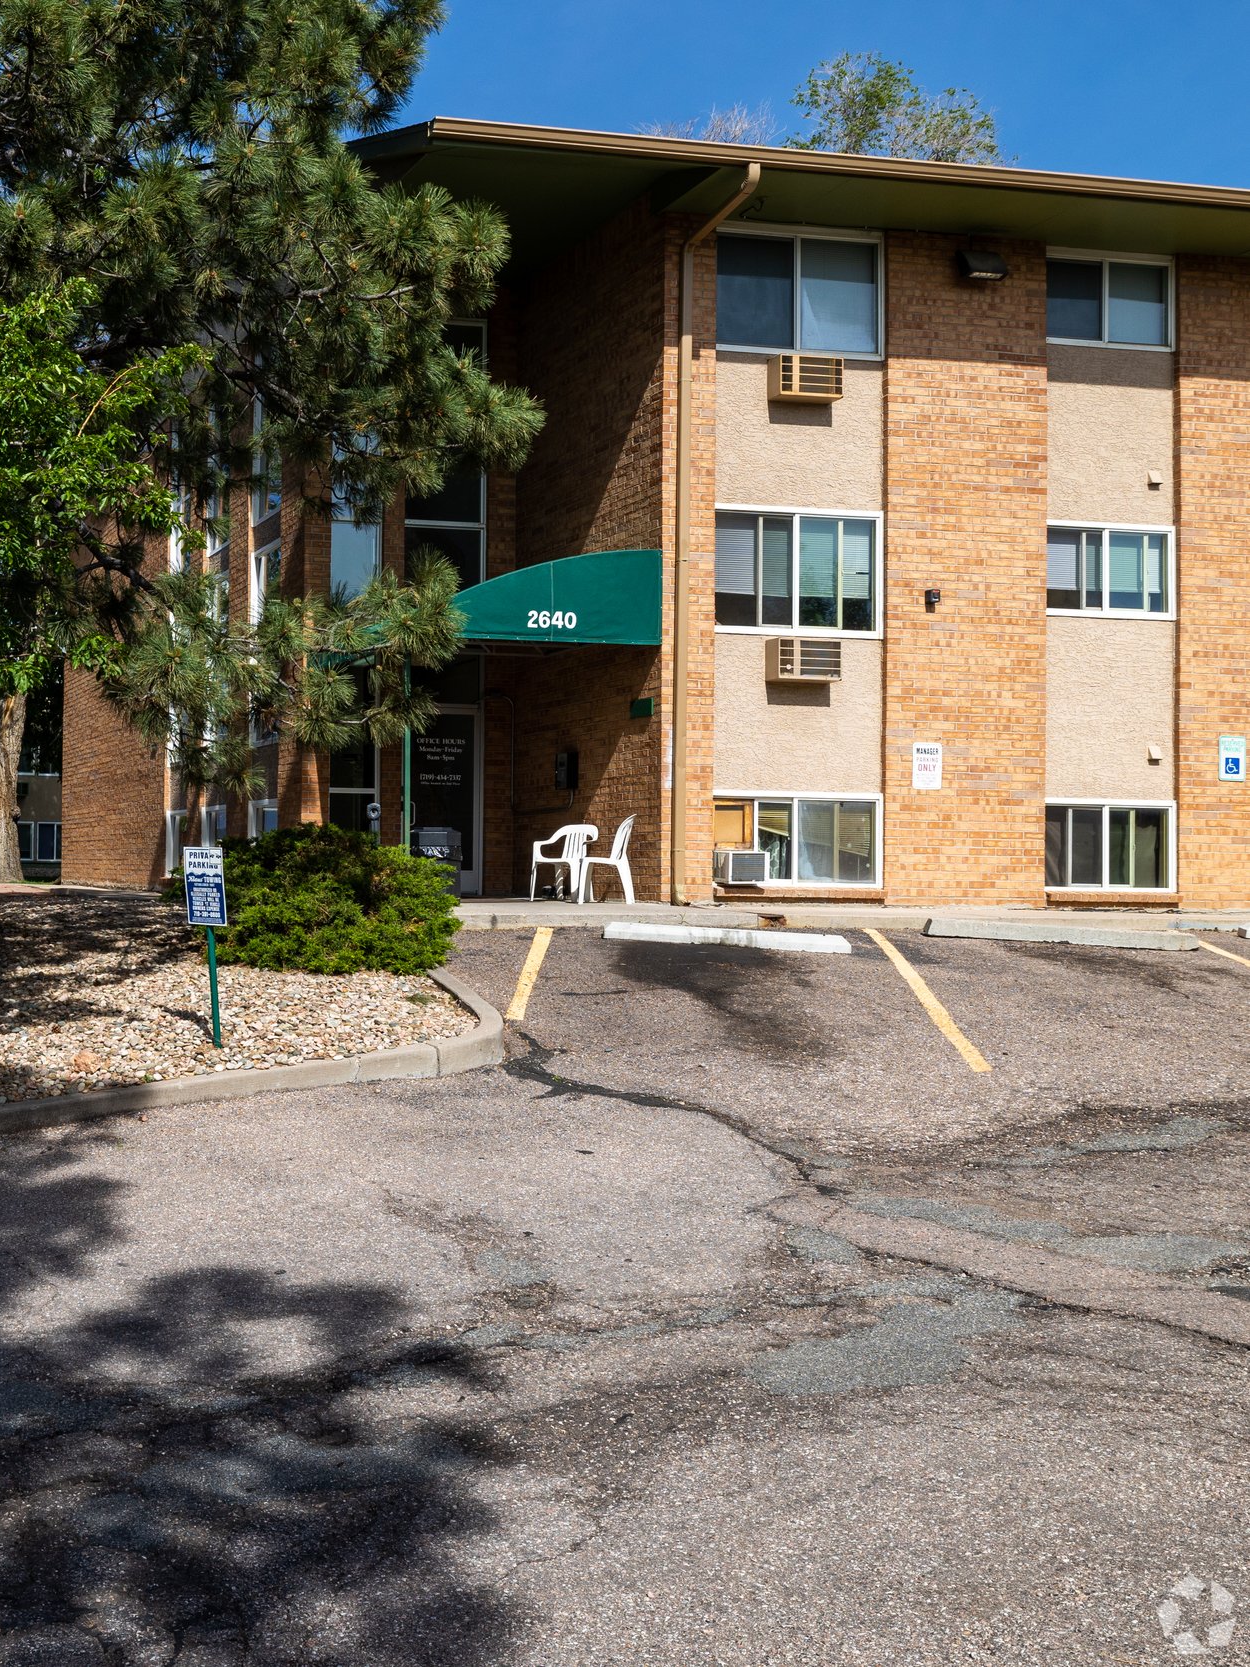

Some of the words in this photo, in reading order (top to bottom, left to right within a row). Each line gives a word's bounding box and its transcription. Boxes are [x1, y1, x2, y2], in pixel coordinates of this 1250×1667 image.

[527, 610, 577, 629] 2640
[916, 747, 939, 755] MANAGER
[918, 763, 937, 772] ONLY
[189, 851, 209, 860] PRIVA
